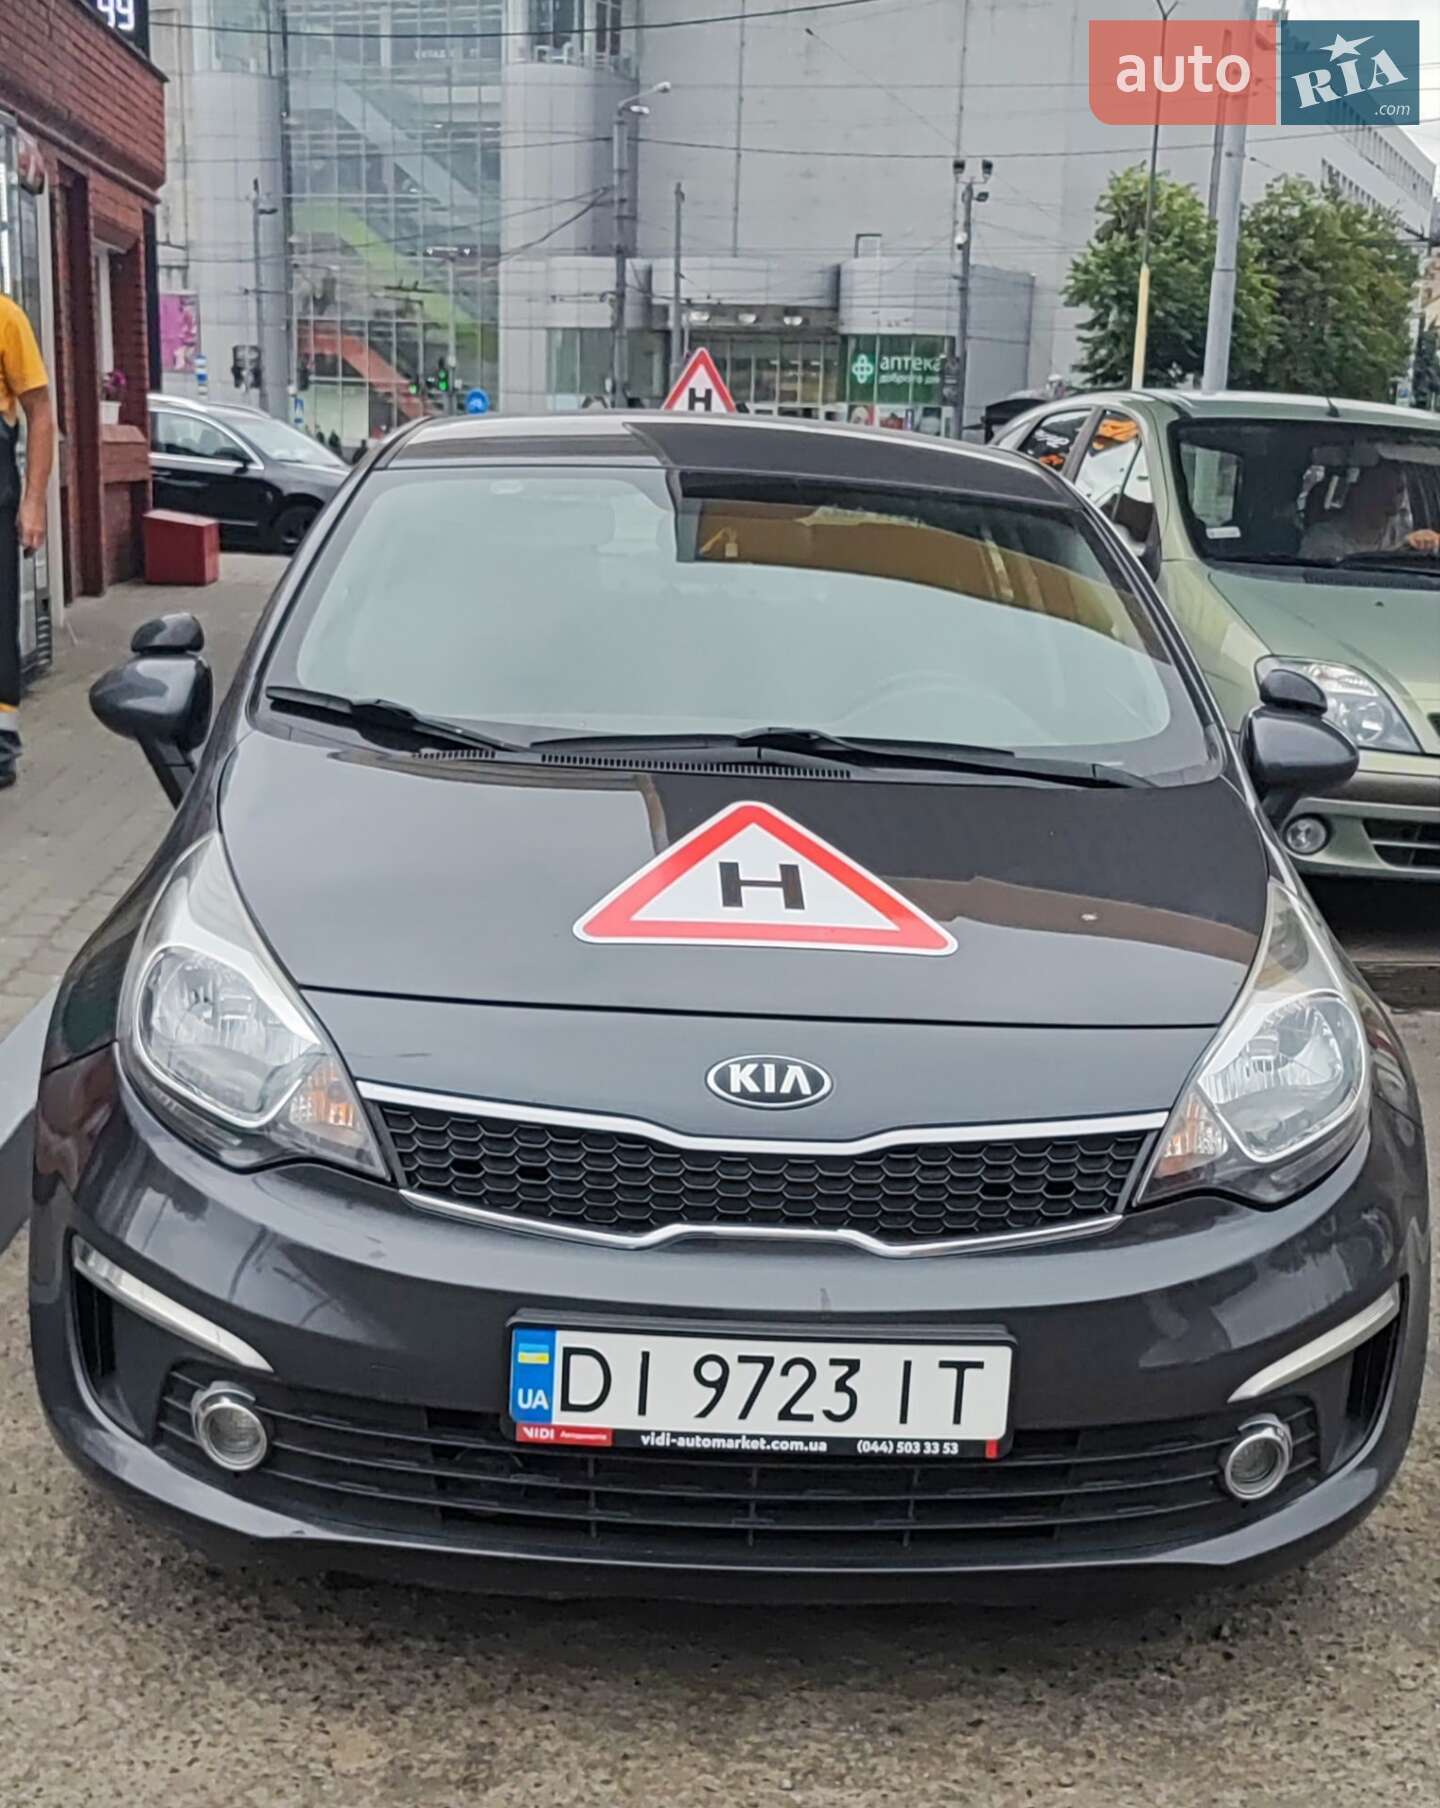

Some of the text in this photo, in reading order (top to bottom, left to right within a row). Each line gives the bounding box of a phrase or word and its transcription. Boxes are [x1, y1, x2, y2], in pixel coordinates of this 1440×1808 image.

[880, 356, 942, 372] аптека
[728, 1063, 812, 1095] KIA
[559, 1345, 986, 1426] DI 9723 IT
[517, 1388, 549, 1411] UA
[523, 1427, 555, 1440] VIDI
[641, 1432, 960, 1456] vidi-automarket.com.ua (044) 503 33 53
